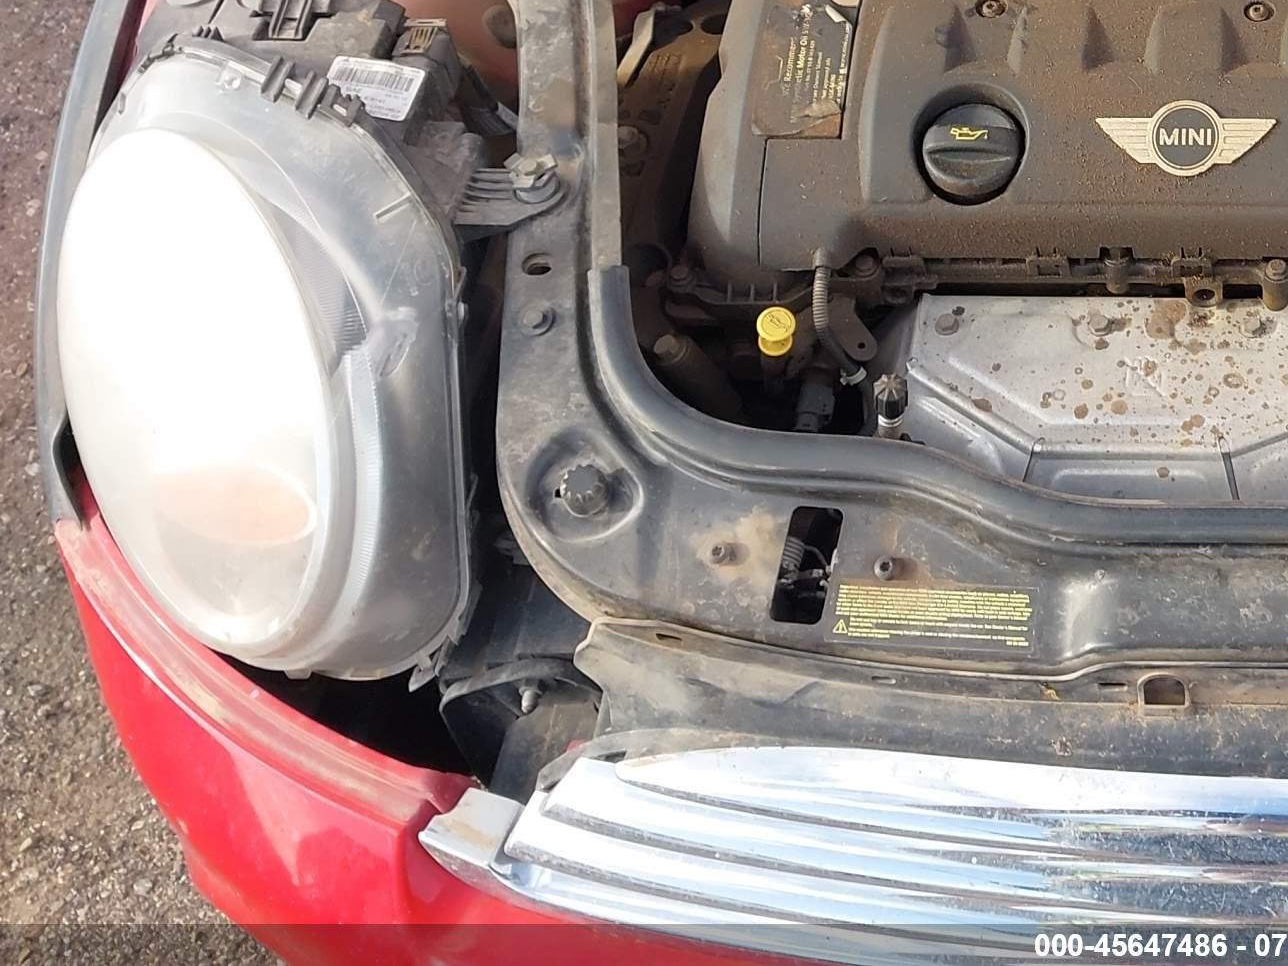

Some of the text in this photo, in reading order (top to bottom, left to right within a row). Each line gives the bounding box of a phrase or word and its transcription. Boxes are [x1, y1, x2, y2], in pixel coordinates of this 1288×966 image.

[799, 35, 809, 46] Oil
[796, 47, 807, 69] Motor
[1159, 128, 1212, 146] MINI
